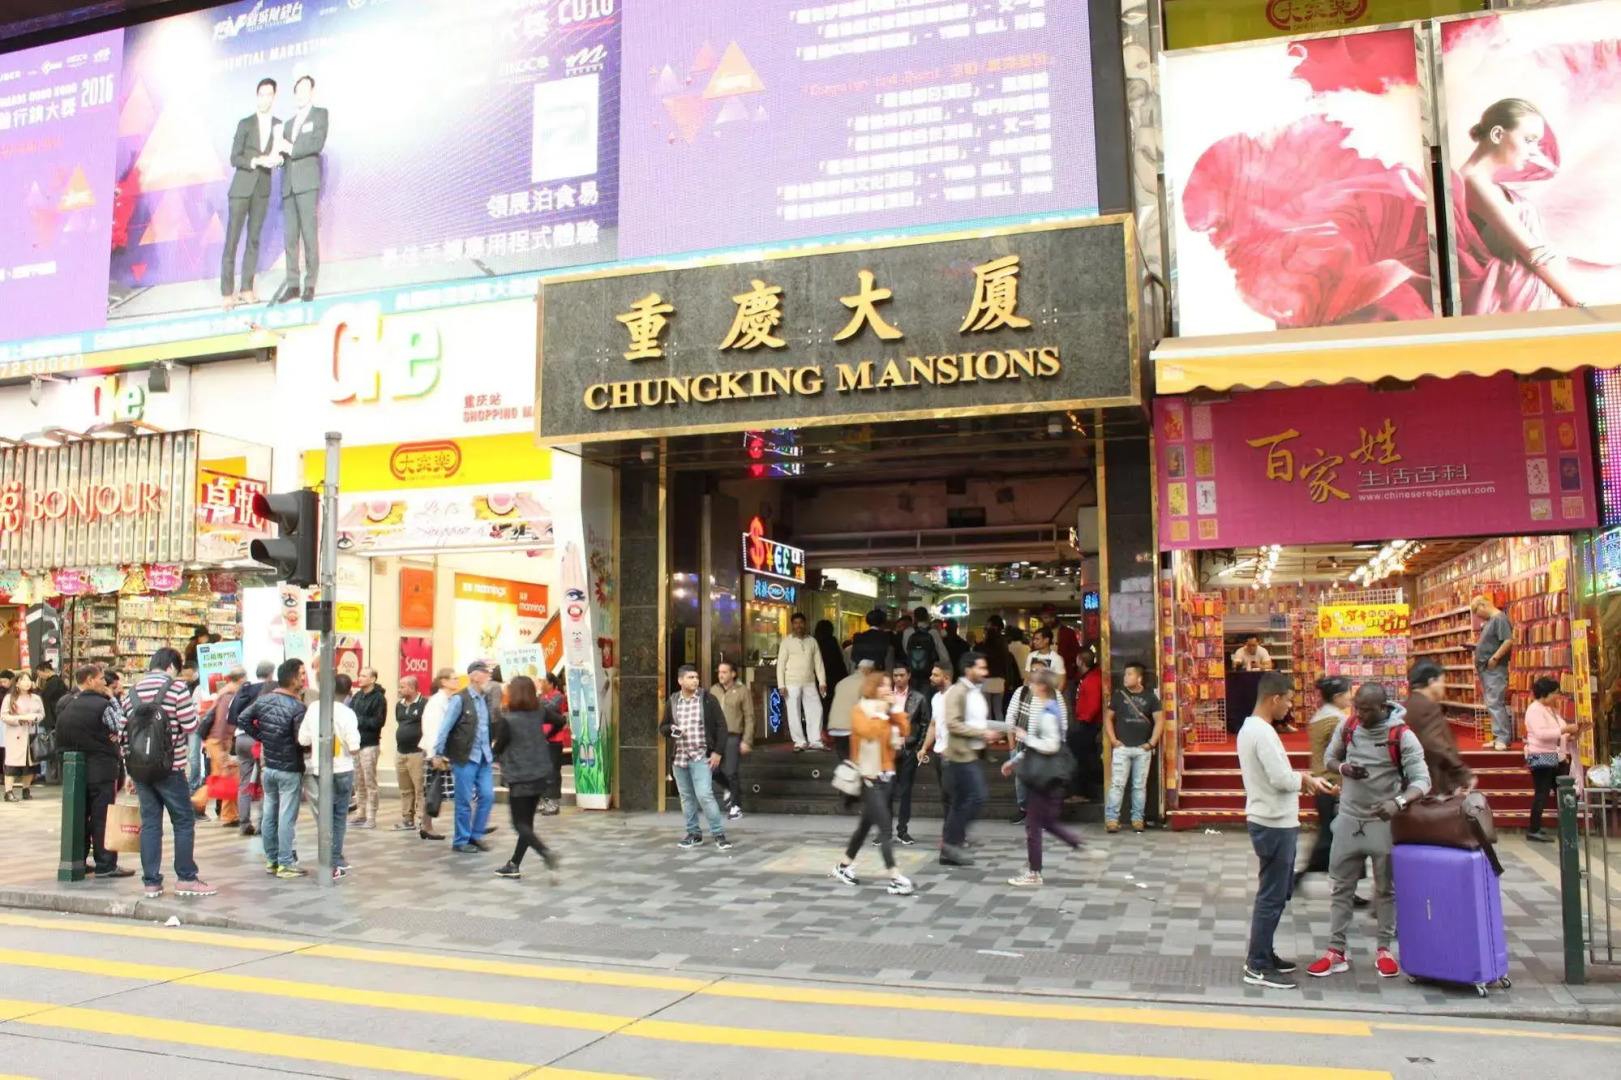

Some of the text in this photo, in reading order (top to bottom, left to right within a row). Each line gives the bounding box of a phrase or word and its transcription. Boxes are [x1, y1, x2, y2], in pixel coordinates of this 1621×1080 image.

[80, 73, 114, 108] 2016
[583, 346, 1062, 412] CHUNGKING MANSIONS
[463, 407, 519, 423] SHOPPING
[1246, 418, 1402, 503] 百家姓
[1357, 463, 1471, 488] 生活百科
[31, 480, 162, 523] BONJOUR
[1358, 487, 1496, 502] www.chineseredpacket.com
